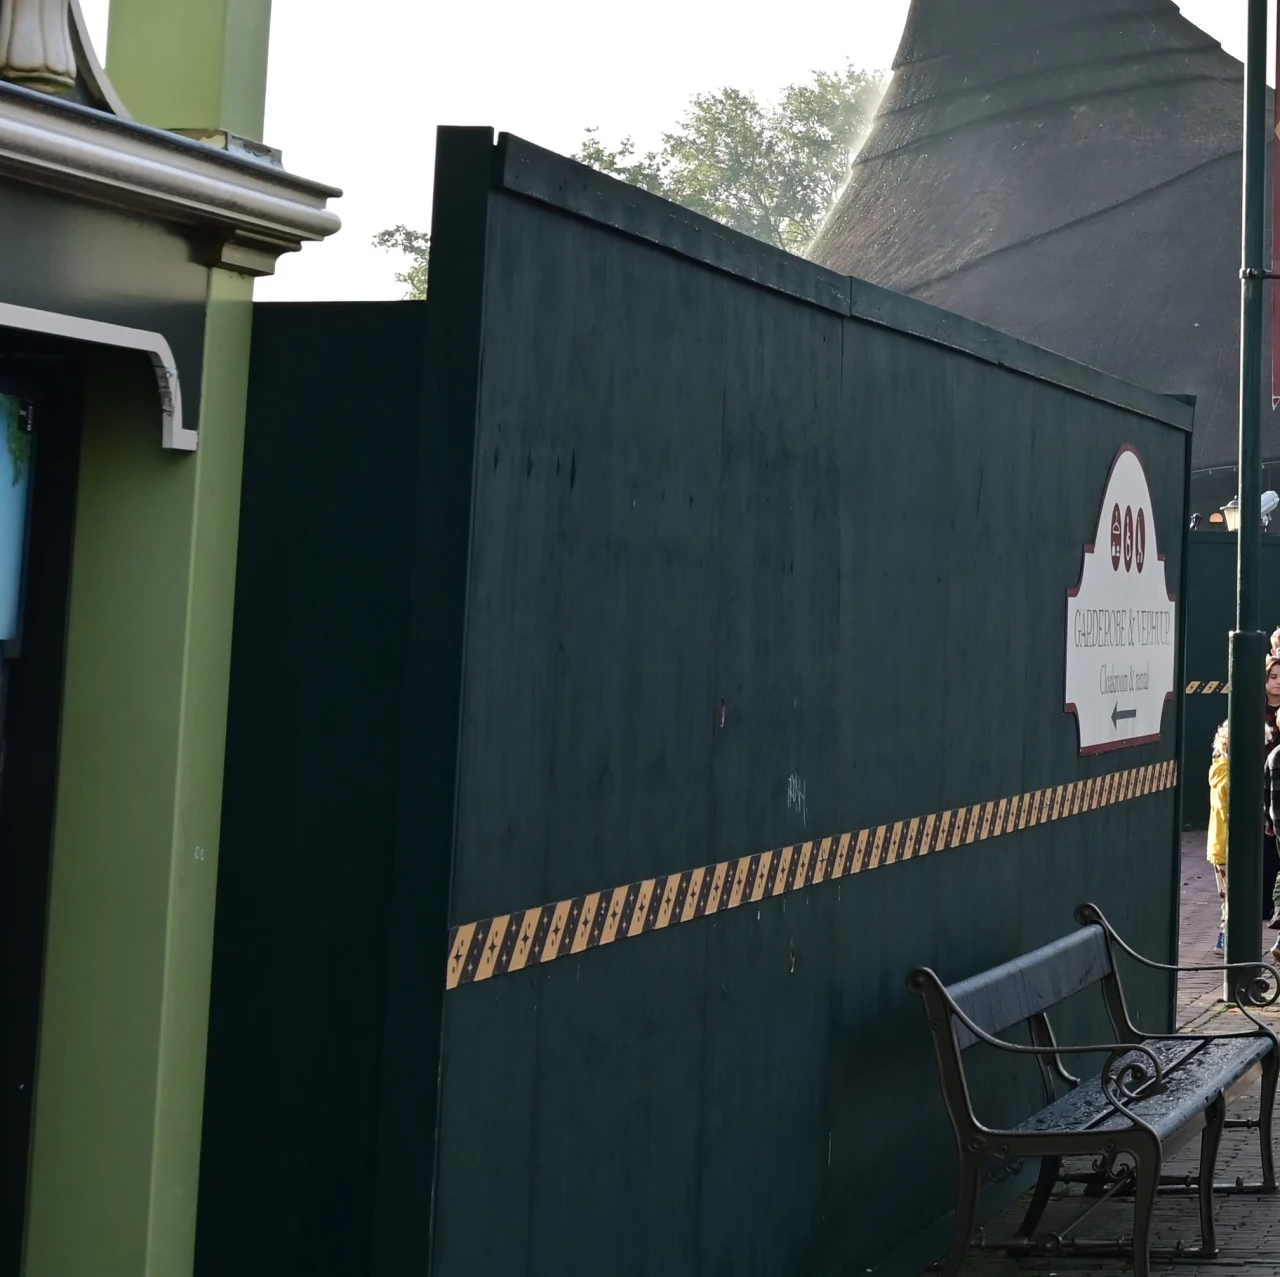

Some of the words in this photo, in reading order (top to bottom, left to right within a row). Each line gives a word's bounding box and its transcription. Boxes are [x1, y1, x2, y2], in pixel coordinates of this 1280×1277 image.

[1074, 609, 1126, 648] GARDEROBE
[1128, 608, 1136, 647] &
[1136, 610, 1171, 646] VERHUUR
[1100, 663, 1128, 695] Cloakroom
[1128, 664, 1135, 692] &
[1136, 660, 1149, 691] rental
